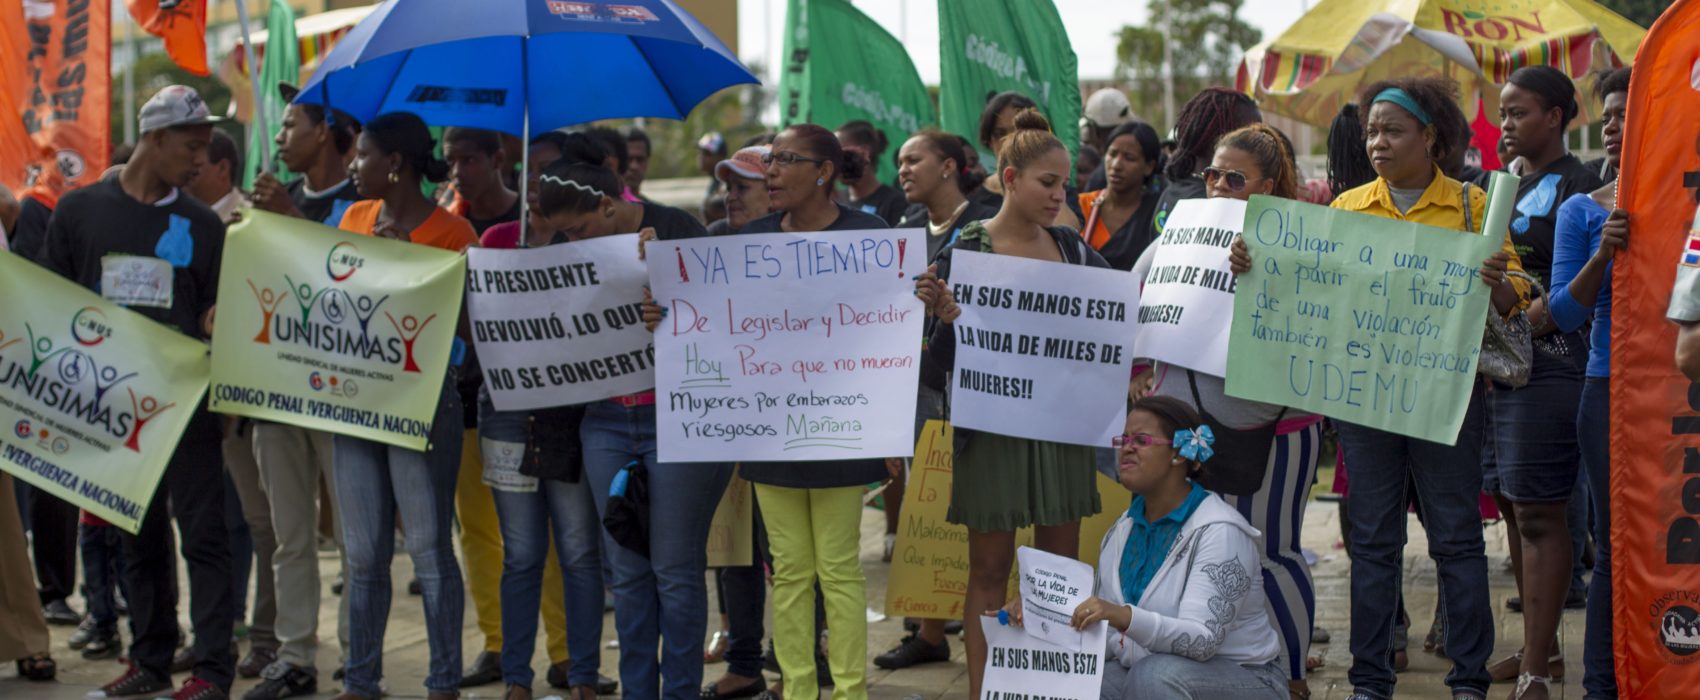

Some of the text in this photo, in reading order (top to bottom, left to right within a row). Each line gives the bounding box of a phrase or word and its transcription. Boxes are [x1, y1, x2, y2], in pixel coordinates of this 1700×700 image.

[1440, 6, 1548, 40] BON
[1161, 228, 1175, 246] EN
[1174, 227, 1196, 244] SUS
[1256, 208, 1344, 270] Obligar
[1359, 245, 1372, 265] a
[1394, 252, 1428, 272] una
[744, 244, 782, 278] ES
[786, 238, 908, 280] TIEMPO!
[1148, 266, 1160, 284] LA
[1160, 266, 1182, 284] VIDA
[1180, 266, 1200, 285] DE
[468, 262, 600, 294] EL PRESIDENTE
[1264, 256, 1456, 310] a parir el fruto
[953, 283, 1126, 322] EN SUS MANOS ESTA
[1256, 280, 1440, 340] de una violación
[475, 312, 572, 342] DEVOLVIÓ,
[572, 313, 600, 336] LO
[672, 298, 912, 342] De Legislar y Decidir
[1251, 310, 1328, 350] también
[1346, 340, 1372, 359] es
[276, 314, 401, 364] UNISIMAS
[958, 325, 1124, 365] LA VIDA DE MILES DE
[488, 368, 516, 390] NO
[517, 366, 546, 390] SE
[686, 343, 912, 382] Hoy Para que no mueran
[216, 383, 264, 406] CODIGO
[268, 392, 303, 415] PENAL
[786, 390, 869, 408] embarazos
[960, 368, 1034, 400] MUJERES!!
[1290, 355, 1420, 414] UDEMU
[682, 414, 862, 442] riesgosos Mañana
[918, 469, 936, 502] La
[1038, 579, 1047, 590] LA
[1050, 580, 1066, 594] VIDA
[1068, 586, 1079, 596] DE
[992, 646, 1098, 676] EN SUS MANOS ESTA
